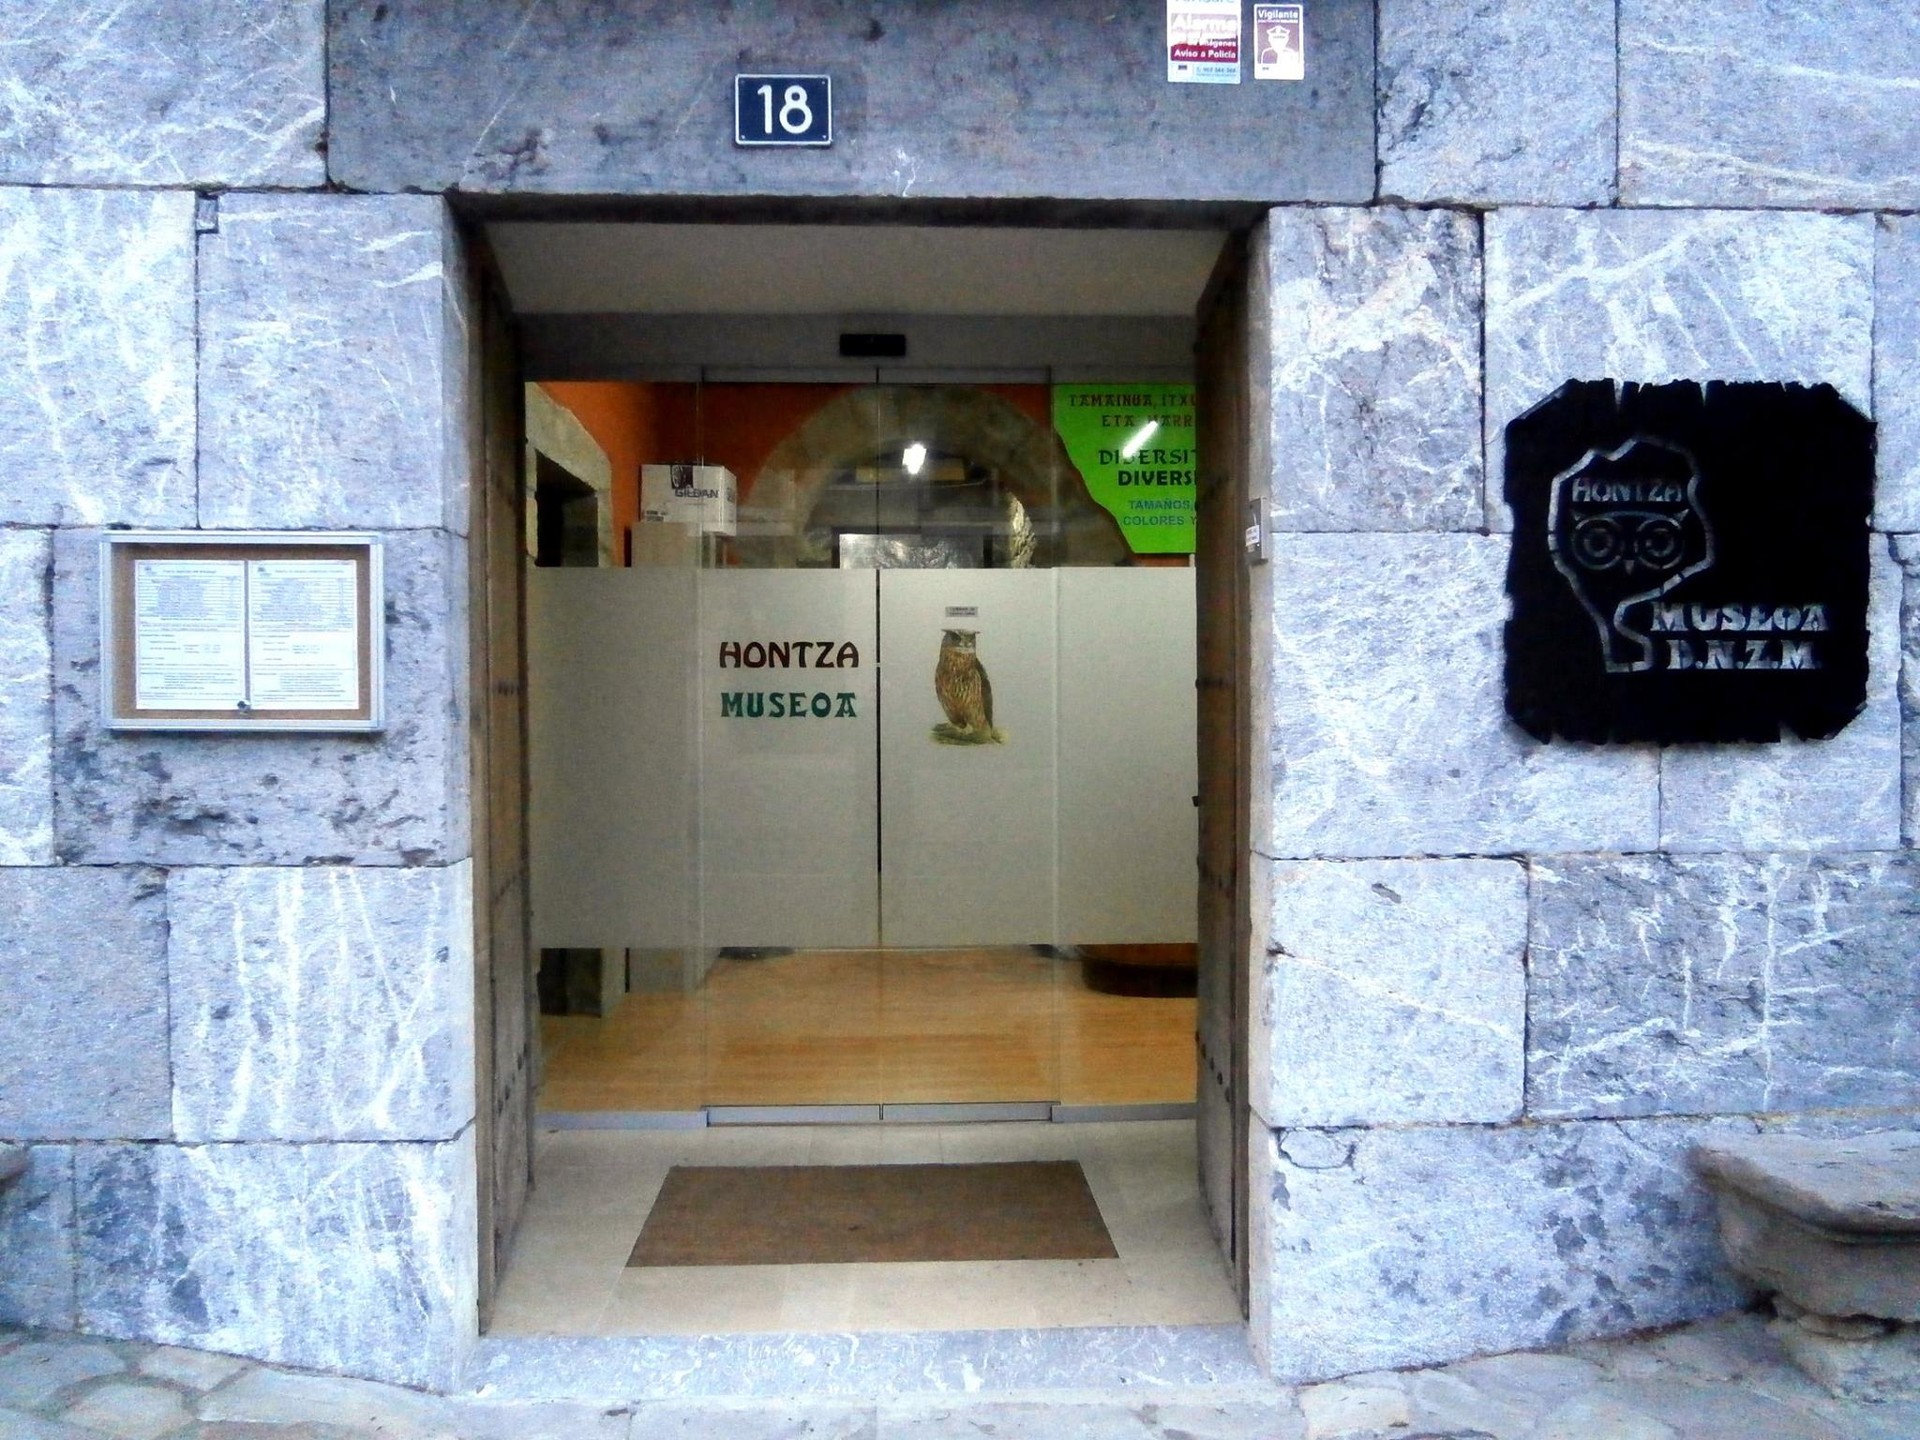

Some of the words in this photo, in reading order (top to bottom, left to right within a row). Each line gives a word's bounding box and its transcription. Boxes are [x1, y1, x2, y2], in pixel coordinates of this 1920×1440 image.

[1258, 9, 1298, 20] Vigilante
[1174, 48, 1198, 58] Aviso
[757, 84, 813, 134] 18
[1102, 415, 1134, 427] ETA
[1572, 477, 1682, 502] HONTZA
[1123, 515, 1184, 526] COLORES
[1650, 602, 1829, 631] MUSEOA
[719, 641, 859, 668] HONTZA
[720, 692, 857, 718] MUSEOA
